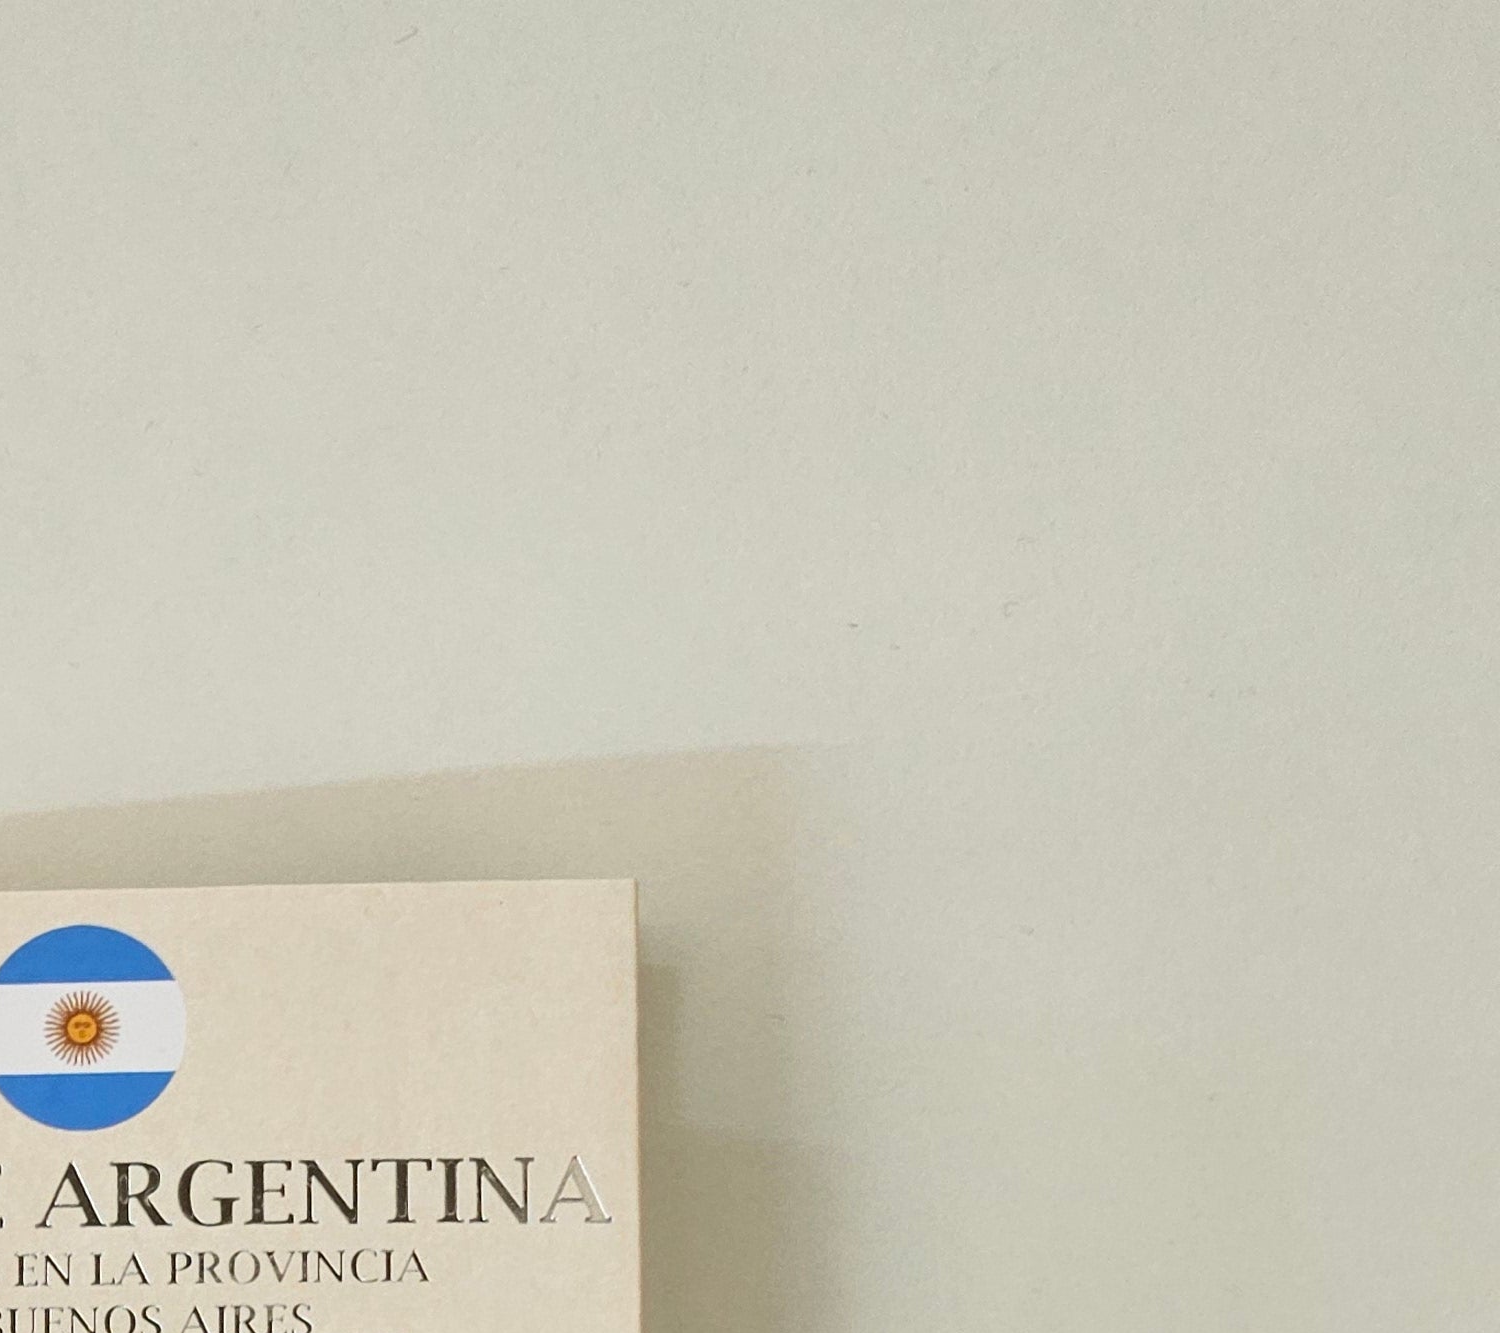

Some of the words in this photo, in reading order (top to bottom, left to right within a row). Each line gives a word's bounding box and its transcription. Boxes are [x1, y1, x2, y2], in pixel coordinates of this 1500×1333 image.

[34, 1155, 613, 1228] ARGENTINA
[14, 1251, 73, 1287] EN
[92, 1250, 150, 1286] LA
[168, 1247, 430, 1285] PROVINCIA
